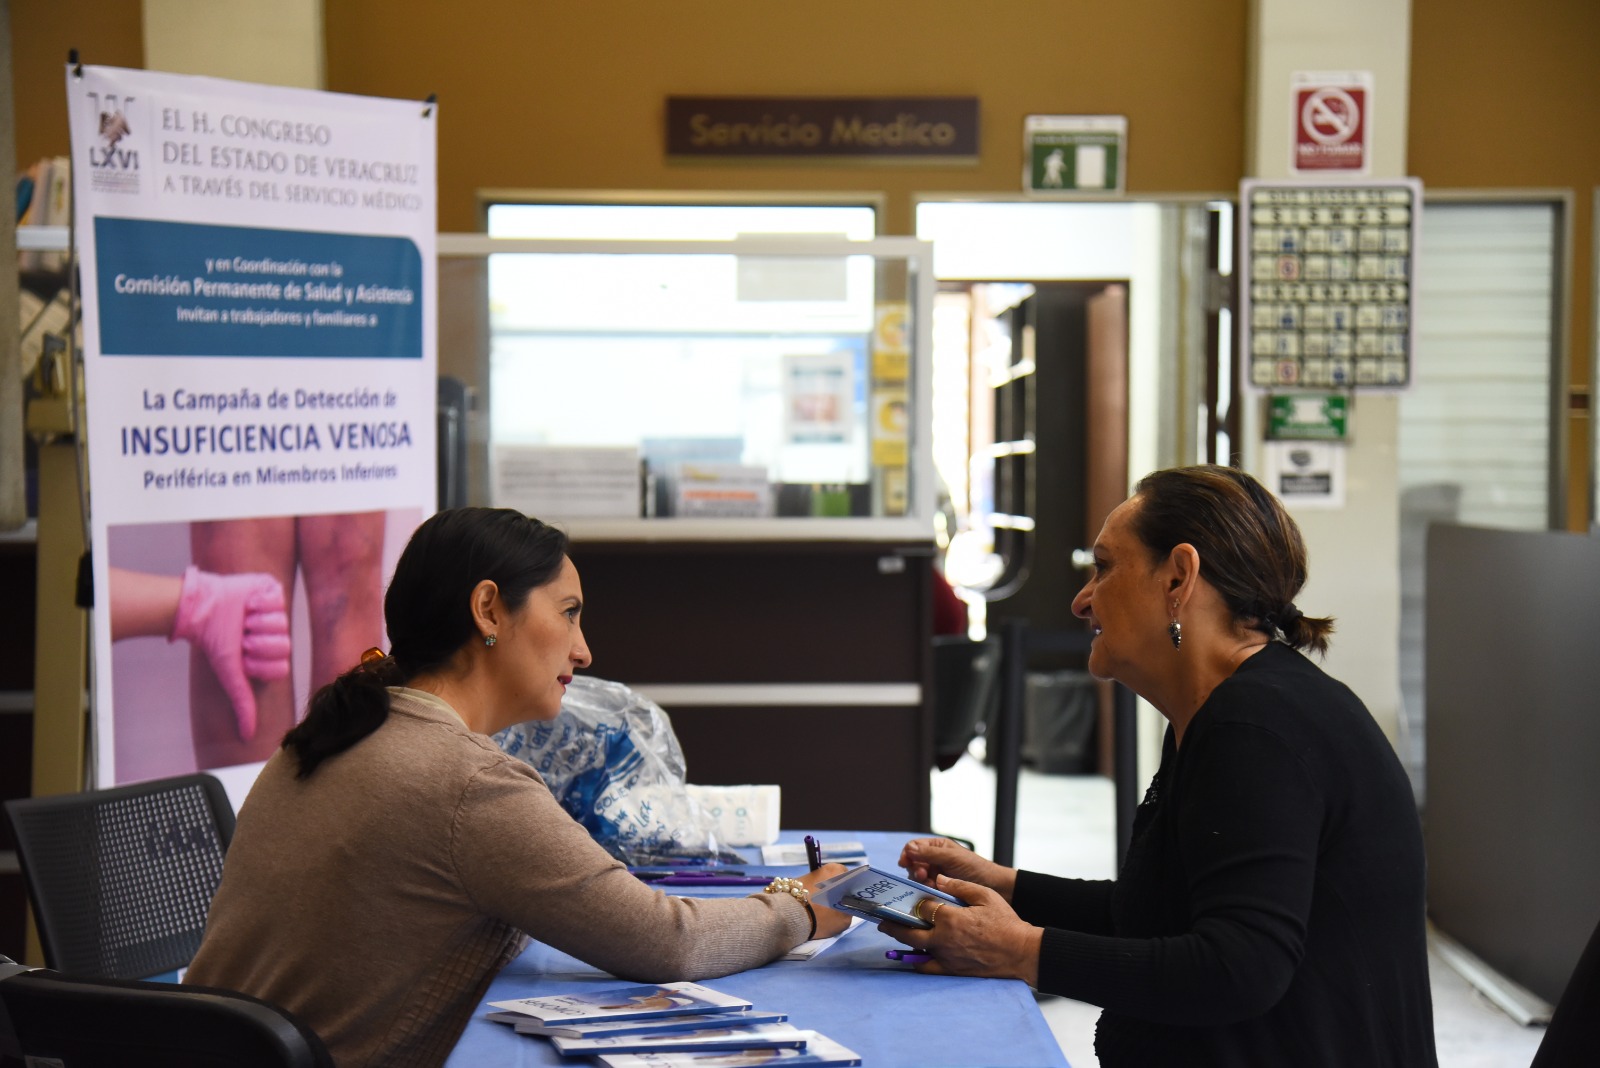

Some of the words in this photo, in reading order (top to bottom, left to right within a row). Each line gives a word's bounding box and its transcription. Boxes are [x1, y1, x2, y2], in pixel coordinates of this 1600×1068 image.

[162, 108, 184, 131] EL
[193, 111, 215, 134] H.
[220, 113, 332, 146] CONGRESO
[690, 113, 821, 146] Servicio
[89, 146, 139, 169] LXVI
[163, 141, 202, 165] DEL
[211, 145, 288, 174] ESTADO
[294, 153, 318, 176] DE
[324, 156, 419, 184] VERACRUZ
[163, 174, 176, 192] A
[179, 174, 242, 198] TRAVÉS
[246, 180, 280, 200] DEL
[285, 183, 358, 207] SERVICIO
[361, 187, 422, 211] MÉDICO
[205, 258, 214, 274] y
[215, 258, 232, 272] en
[233, 256, 308, 276] Coordinación
[309, 262, 328, 277] con
[330, 261, 343, 278] la
[114, 273, 192, 296] Comisión
[194, 277, 282, 300] Permanente
[284, 280, 302, 300] de
[304, 281, 343, 302] Salud
[345, 286, 354, 306] y
[176, 305, 219, 323] Invitan
[221, 310, 229, 323] a
[231, 307, 303, 327] trabajadores
[304, 313, 312, 329] y
[313, 309, 367, 327] familiares
[369, 314, 379, 328] a
[143, 389, 165, 410] La
[173, 387, 262, 415] Campaña
[267, 388, 288, 409] de
[294, 387, 379, 409] Detección
[383, 387, 397, 407] de
[121, 424, 321, 456] INSUFICIENCIA
[328, 421, 412, 450] VENOSA
[143, 467, 228, 490] Periférica
[232, 470, 251, 486] en
[256, 464, 336, 485] Miembros
[341, 461, 397, 482] Inferiores
